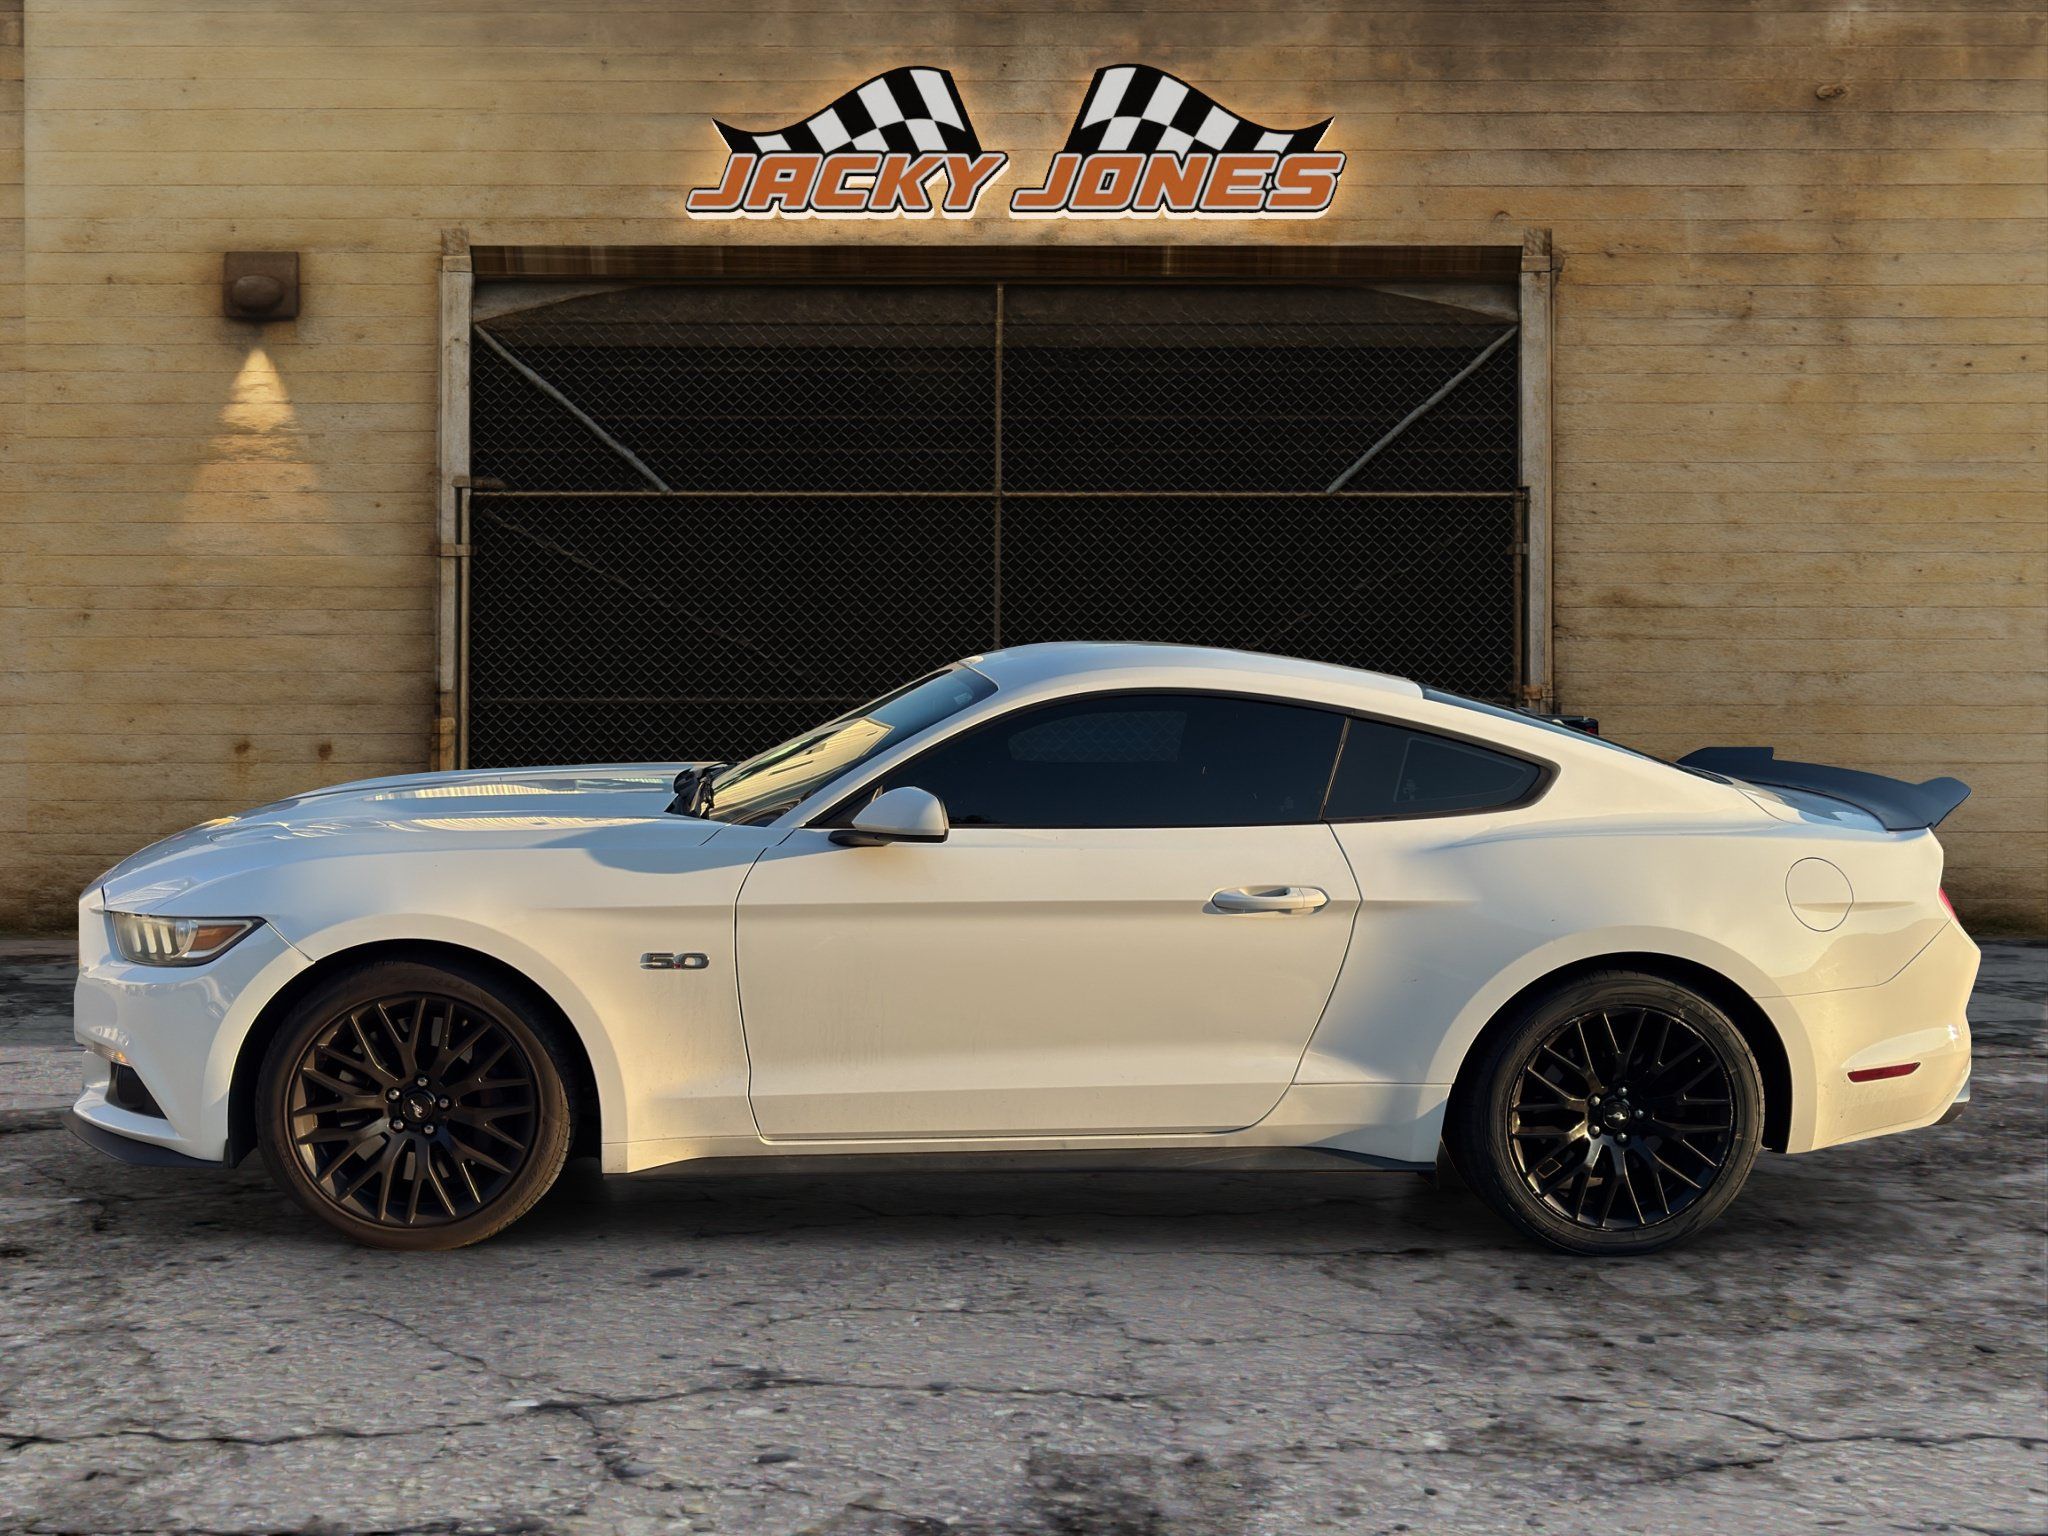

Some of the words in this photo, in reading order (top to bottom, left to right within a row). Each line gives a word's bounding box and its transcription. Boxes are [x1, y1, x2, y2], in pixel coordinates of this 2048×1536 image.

[687, 151, 1008, 213] JACKY
[1010, 151, 1345, 213] JONES
[640, 952, 709, 970] 5.0
